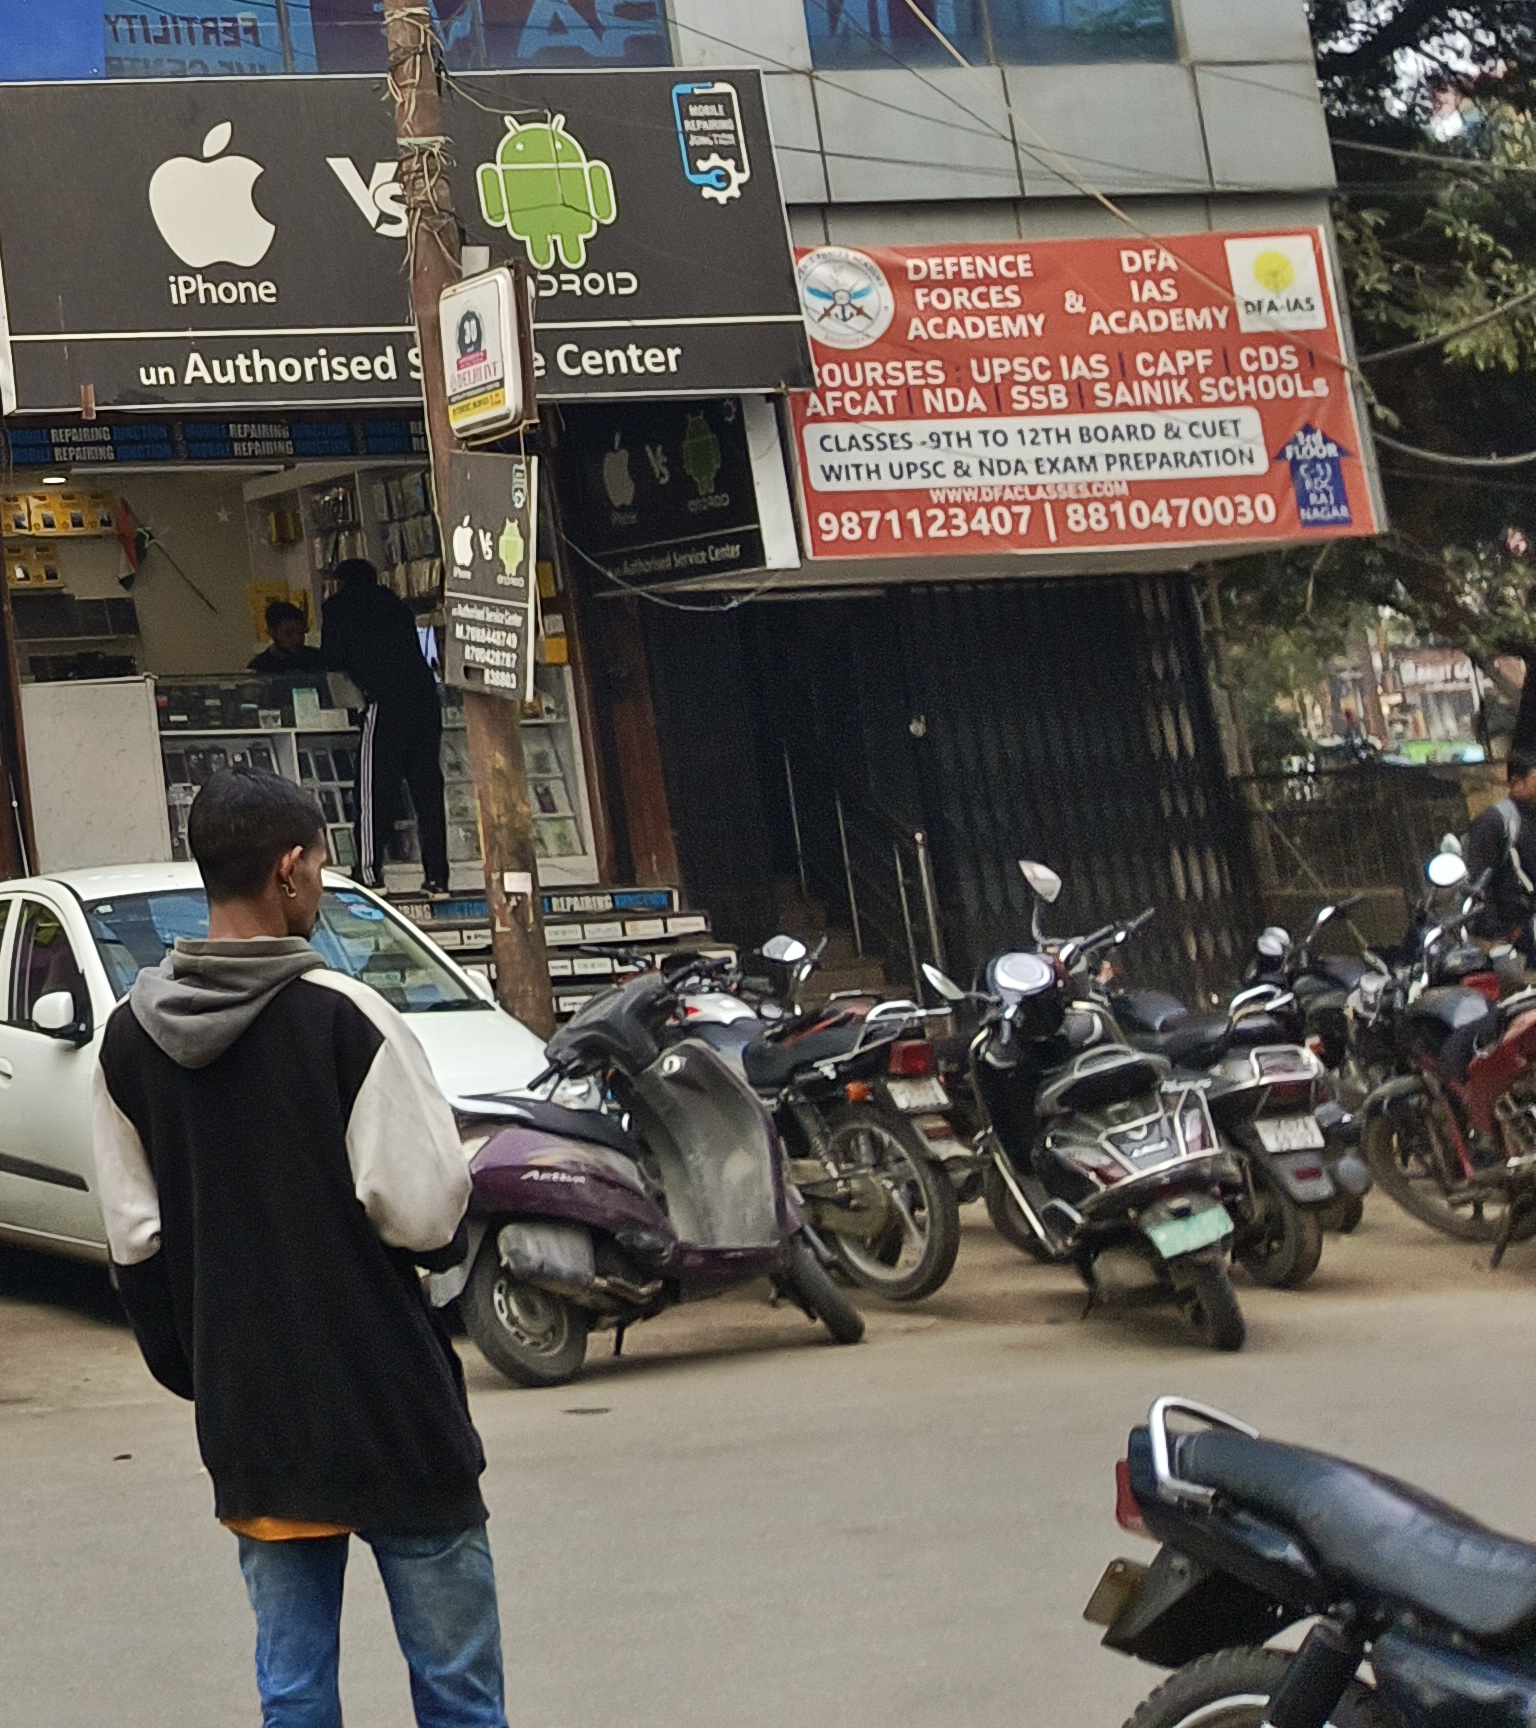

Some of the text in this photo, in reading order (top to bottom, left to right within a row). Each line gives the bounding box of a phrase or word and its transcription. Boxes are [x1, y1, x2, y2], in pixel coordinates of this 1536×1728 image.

[906, 252, 1034, 283] DEFENCE
[1120, 248, 1179, 273] DFA
[168, 275, 278, 306] iPhone
[914, 284, 1022, 312] FORCES
[1063, 290, 1087, 314] &
[1129, 278, 1179, 304] IAS
[906, 312, 1046, 342] ACADEMY
[1088, 305, 1229, 336] ACADEMY
[138, 360, 176, 388] un
[183, 346, 399, 385] Authorised
[556, 342, 682, 377] Center
[970, 355, 1051, 384] UPSC
[1059, 353, 1111, 381] IAS
[1135, 348, 1214, 378] CAPF
[1239, 344, 1300, 373] CDS
[806, 389, 898, 417] AFCAT
[922, 386, 989, 414] NDA
[1010, 383, 1070, 411] SSB
[1093, 377, 1194, 408] SAINIK
[50, 426, 111, 444] REPAIRING
[229, 423, 290, 439] REPAIRING
[818, 431, 913, 453] CLASSES
[976, 428, 1009, 448] TO
[1016, 426, 1073, 446] 12TH
[1078, 422, 1157, 444] BOARD
[1163, 421, 1183, 440] &
[1187, 418, 1243, 439] CUET
[53, 445, 115, 462] REPAIRING
[233, 440, 294, 457] REPAIRING
[818, 446, 1256, 483] WITH UPSC & NDA EXAM PREPARATION
[817, 504, 1032, 542] 9871123407
[1064, 493, 1277, 533] 8810470030
